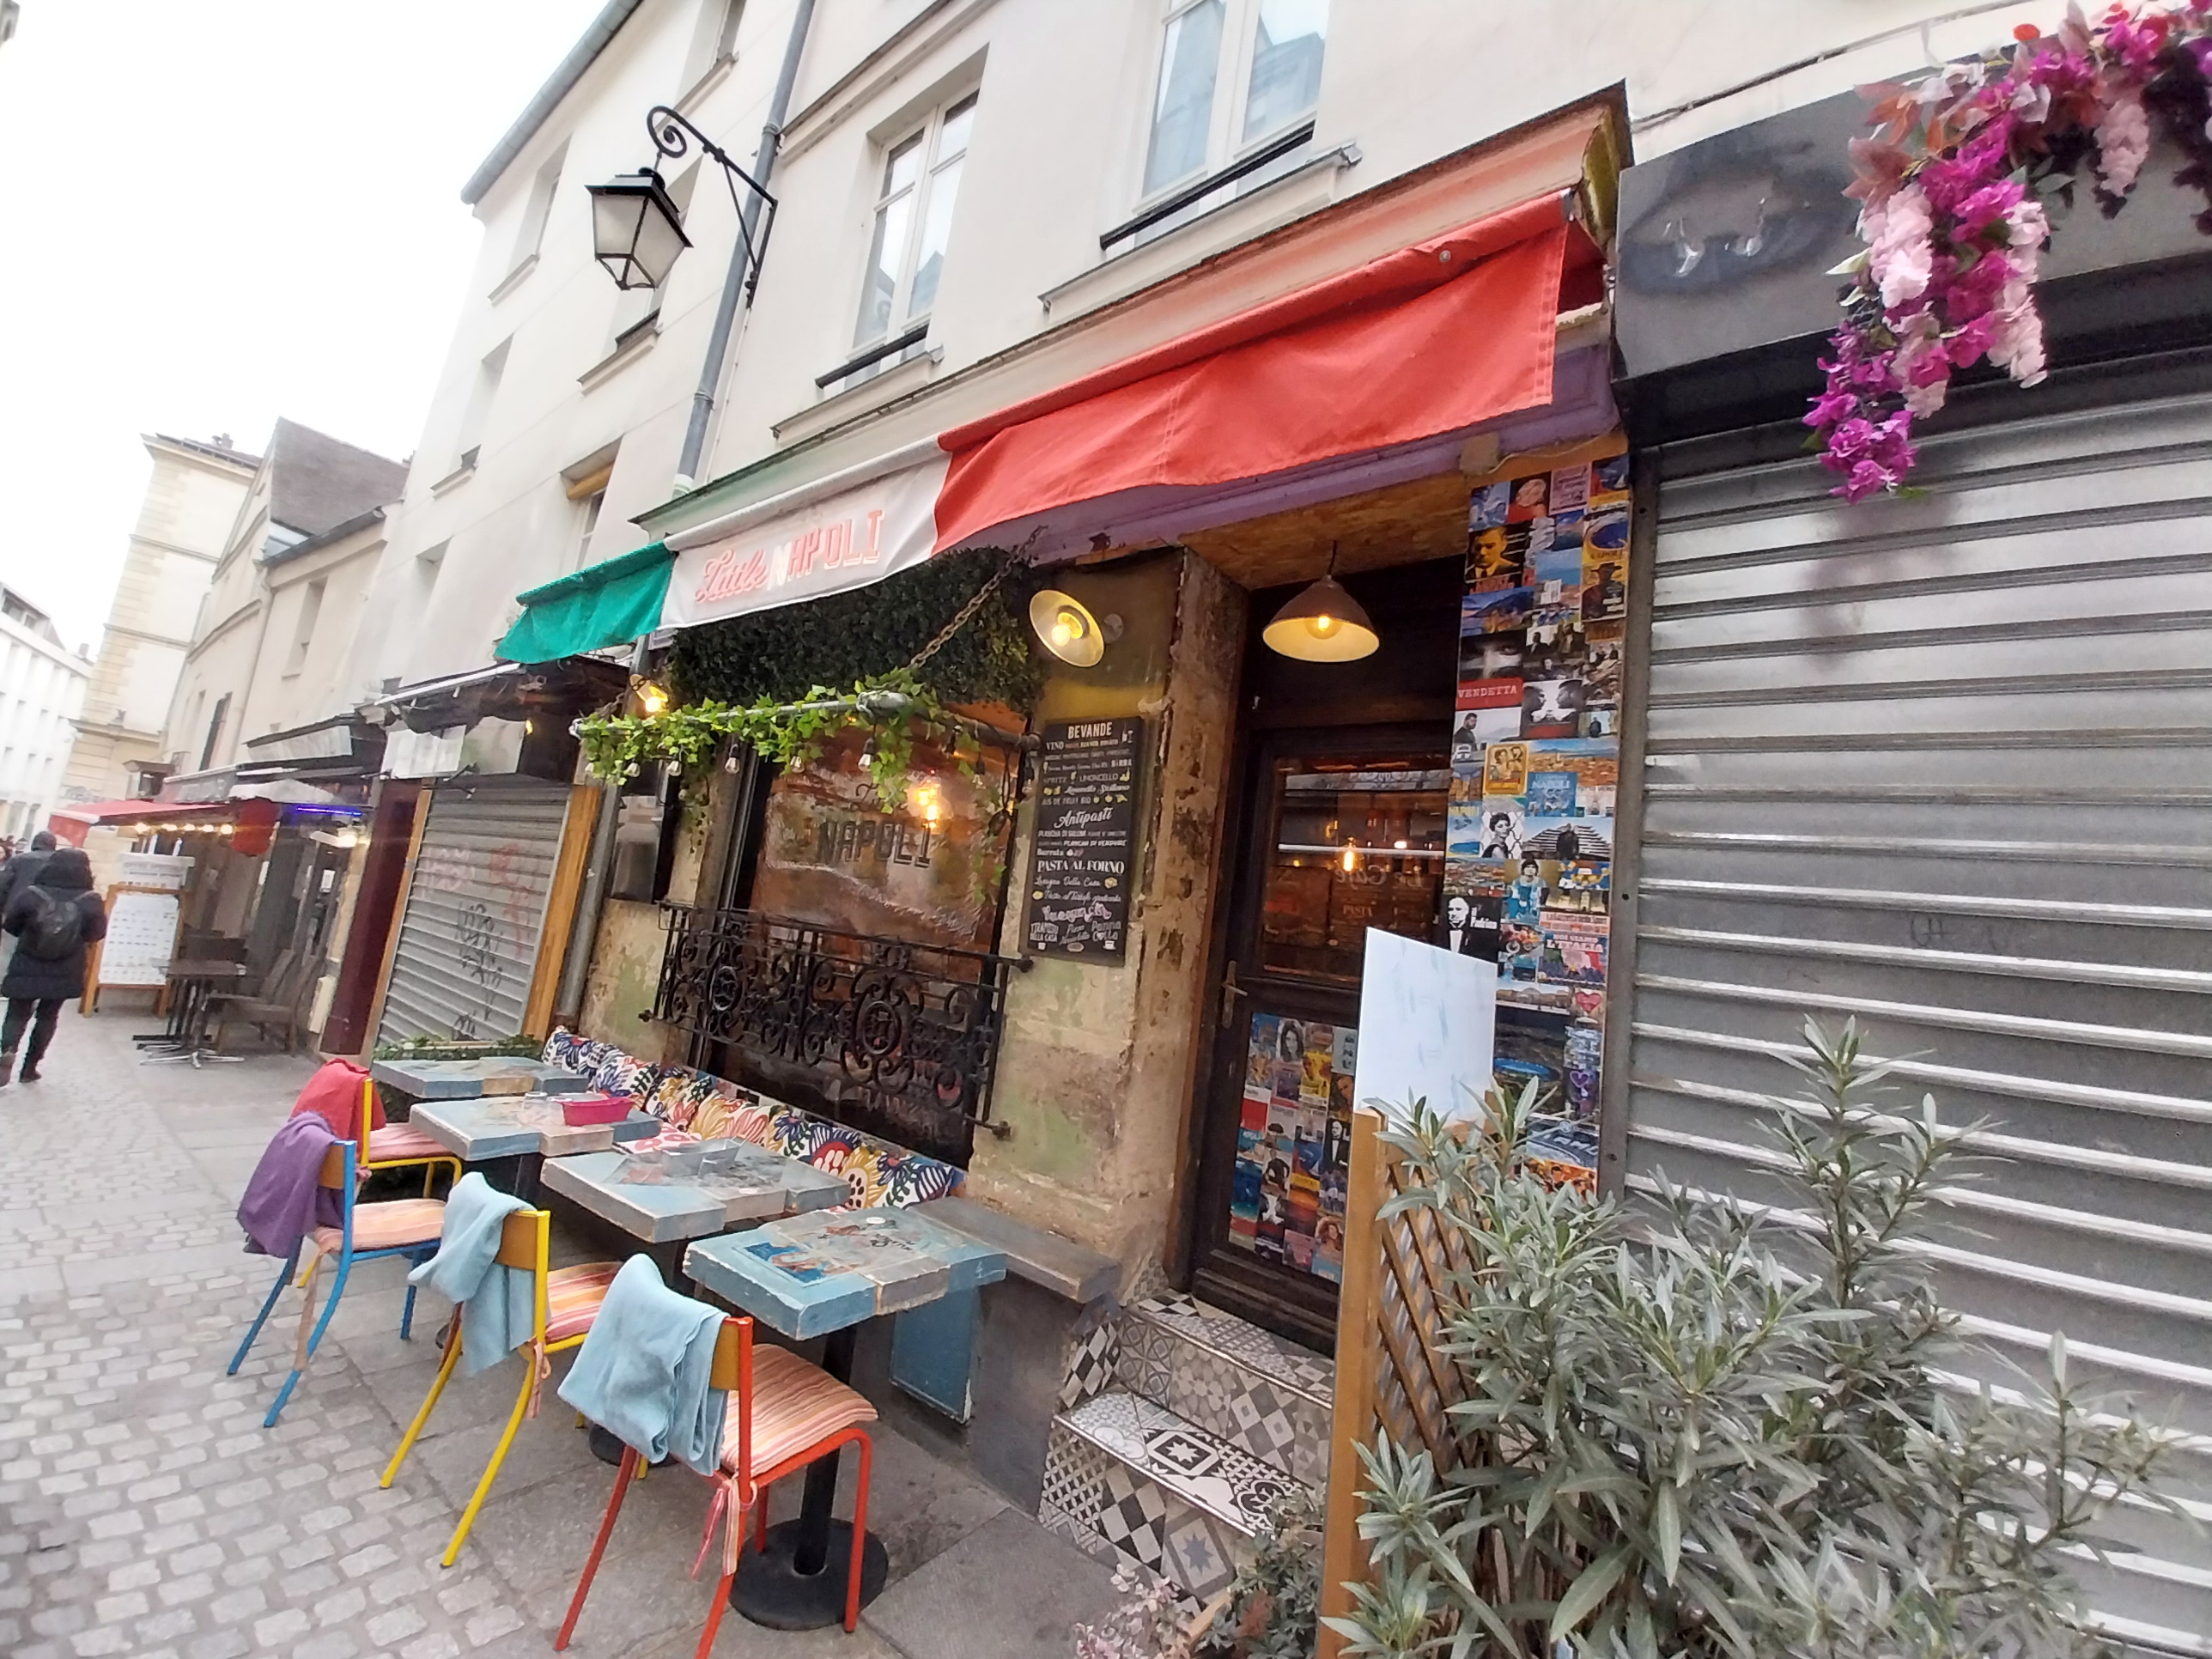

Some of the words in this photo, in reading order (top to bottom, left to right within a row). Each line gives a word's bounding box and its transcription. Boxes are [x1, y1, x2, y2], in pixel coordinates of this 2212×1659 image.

[695, 549, 769, 604] Little
[768, 508, 885, 591] NAPOLI
[1457, 684, 1518, 699] VENDETTA
[1067, 721, 1113, 739] BEVANDE
[1046, 740, 1064, 750] VINO
[1054, 806, 1114, 829] Antipasti
[817, 820, 932, 868] NAPOLI
[1037, 860, 1069, 873] PASTA
[1072, 860, 1085, 871] AL
[1086, 860, 1125, 874] FORNO
